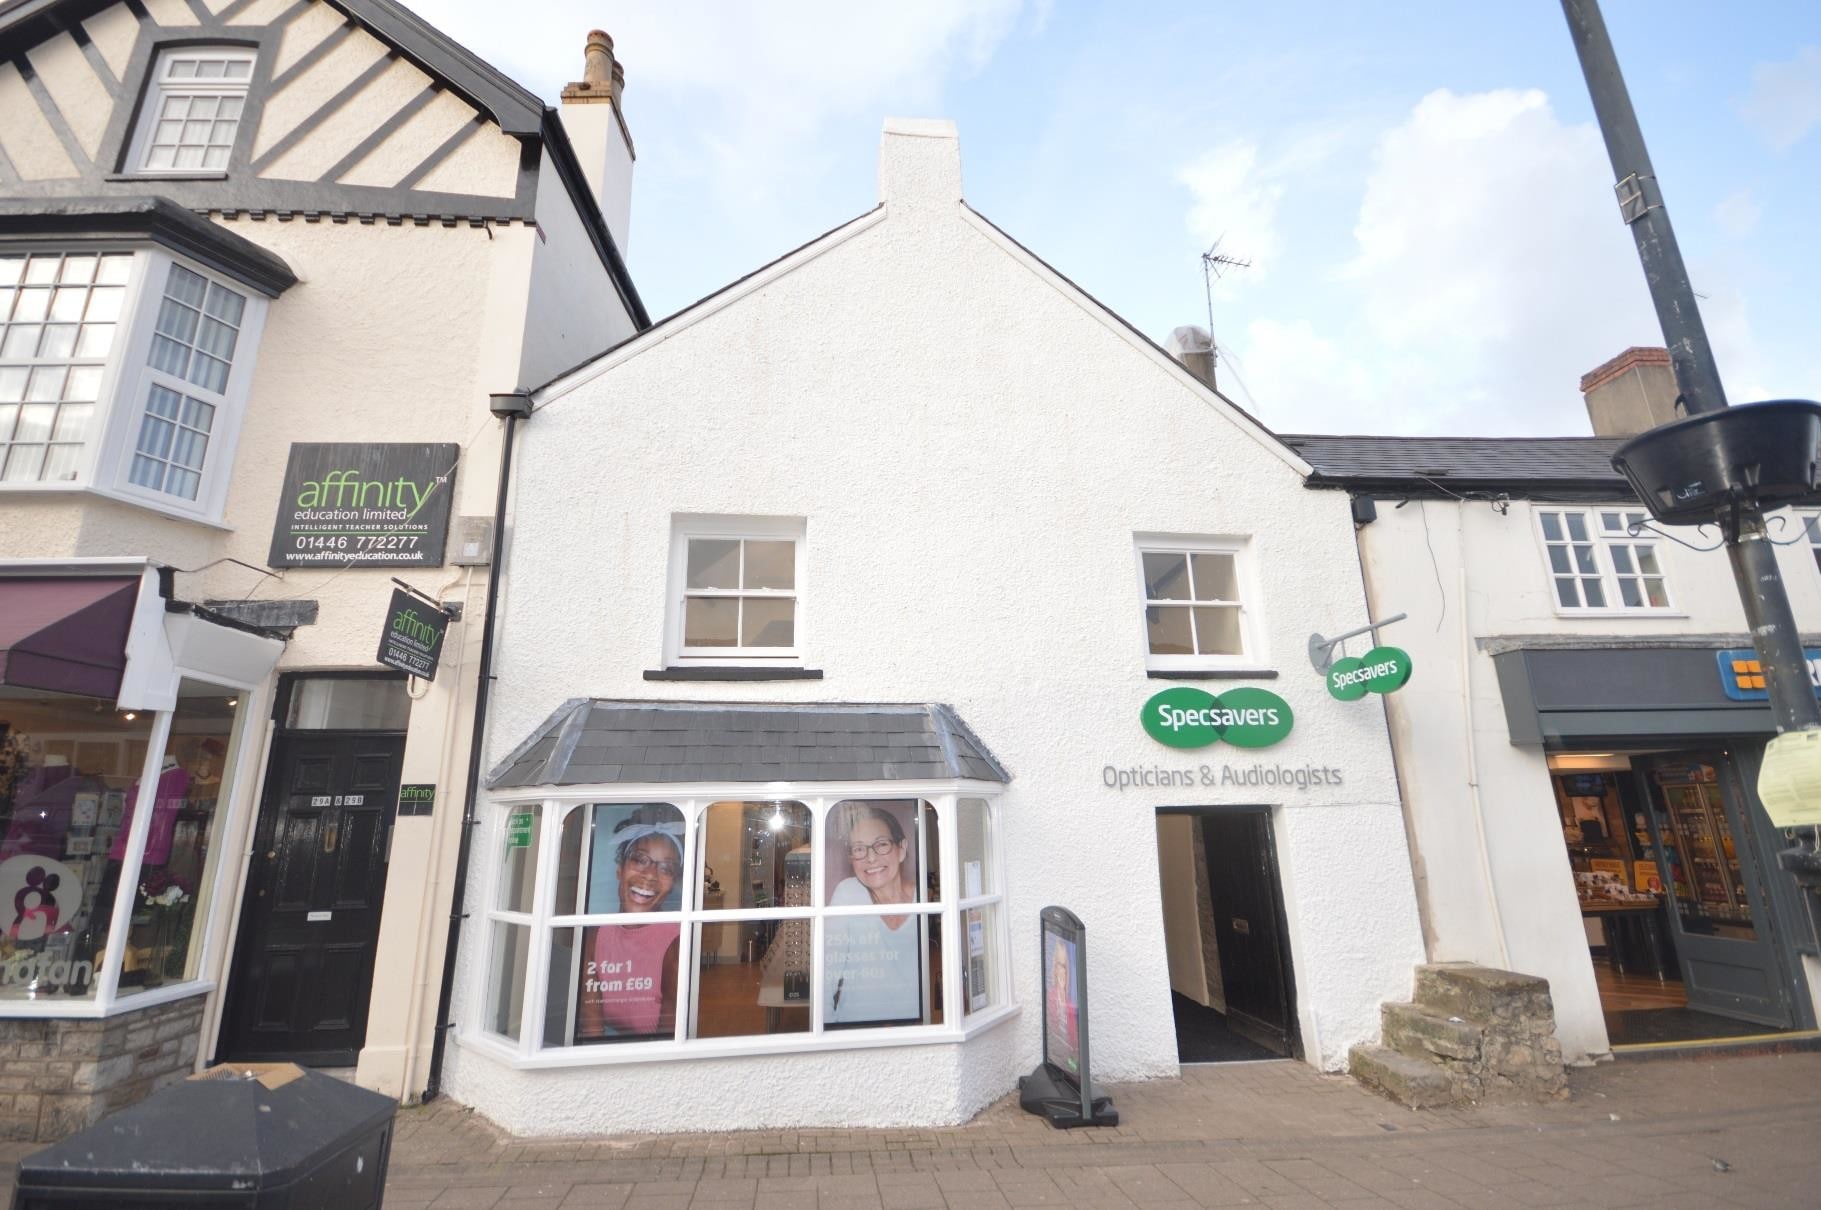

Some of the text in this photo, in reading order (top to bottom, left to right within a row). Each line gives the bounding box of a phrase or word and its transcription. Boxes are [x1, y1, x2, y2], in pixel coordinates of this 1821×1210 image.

[297, 470, 434, 517] affinity
[294, 508, 407, 520] education limited
[296, 536, 418, 549] 01446 772277
[286, 551, 423, 562] www.affinityeducation.co.uk
[393, 609, 439, 650] affinity
[388, 647, 408, 661] 01446
[409, 655, 430, 670] 772277
[1333, 660, 1397, 691] Specsavers
[1158, 704, 1279, 731] Specsavers
[1103, 764, 1342, 791] Opticians & Audiologists
[401, 786, 434, 800] affinity
[587, 960, 632, 975] 2 for 1
[585, 977, 653, 992] from £69
